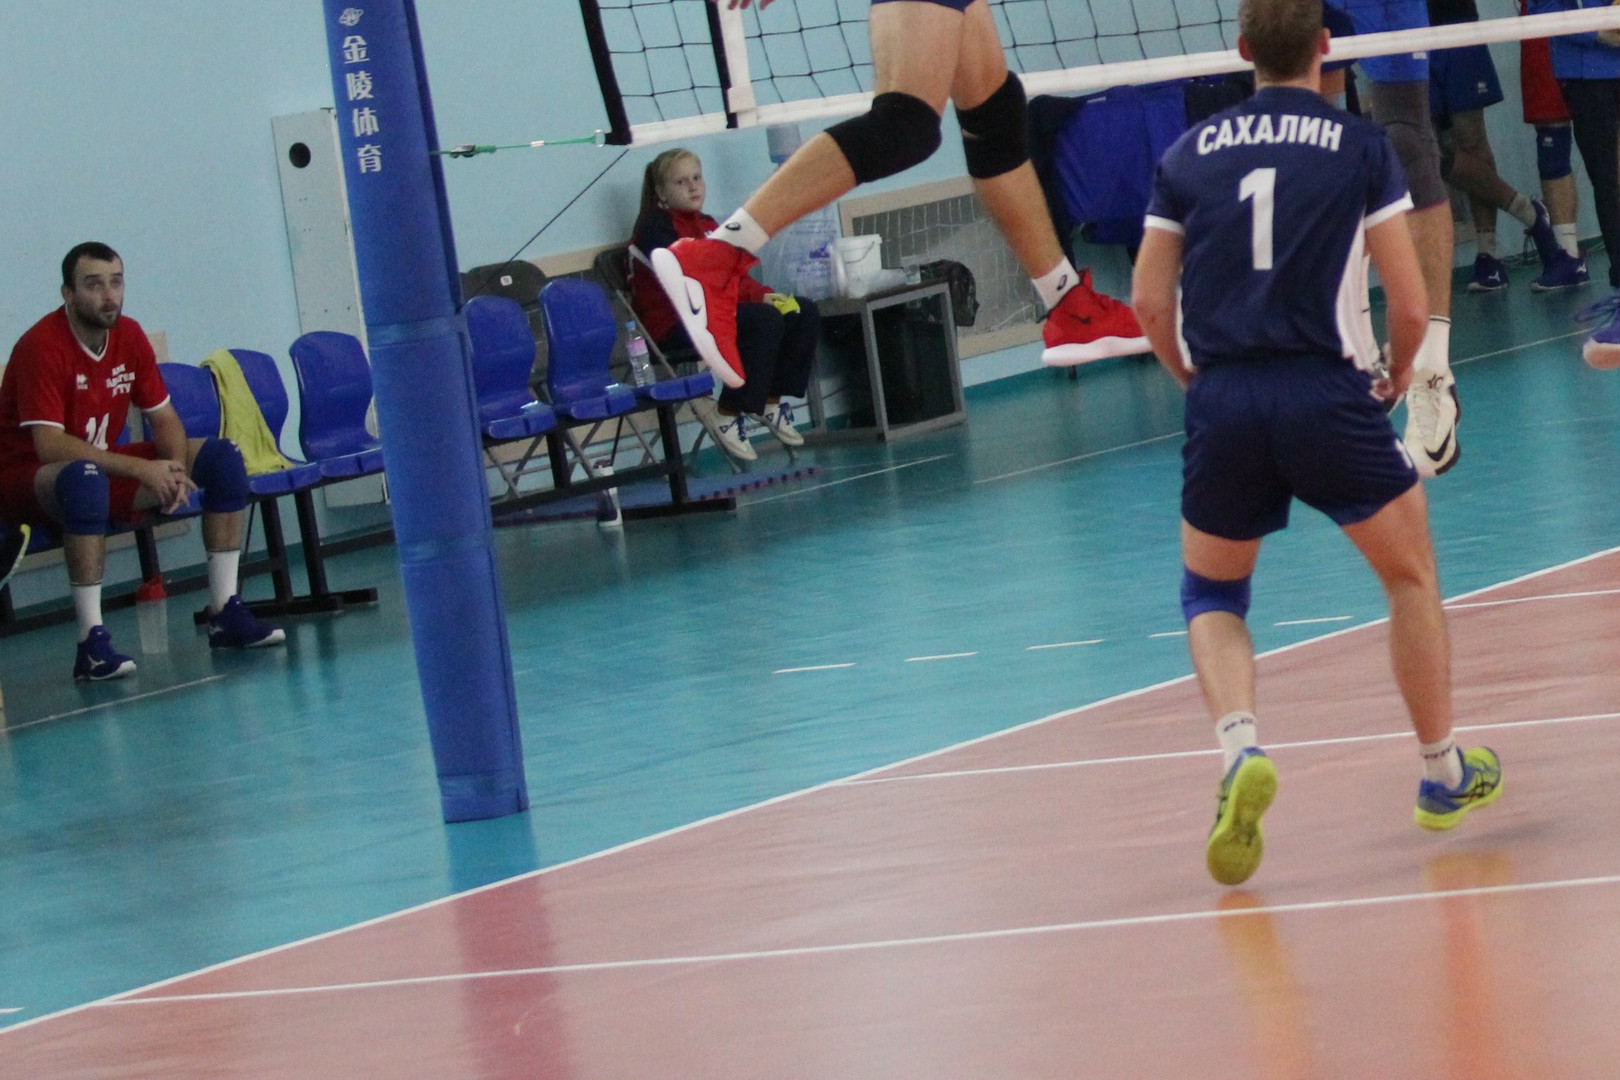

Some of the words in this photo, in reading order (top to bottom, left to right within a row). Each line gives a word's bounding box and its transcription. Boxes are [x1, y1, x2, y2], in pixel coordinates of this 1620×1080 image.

[341, 34, 383, 175] 金陵体育
[1197, 113, 1344, 156] САХАЛИН
[1238, 167, 1276, 270] 1
